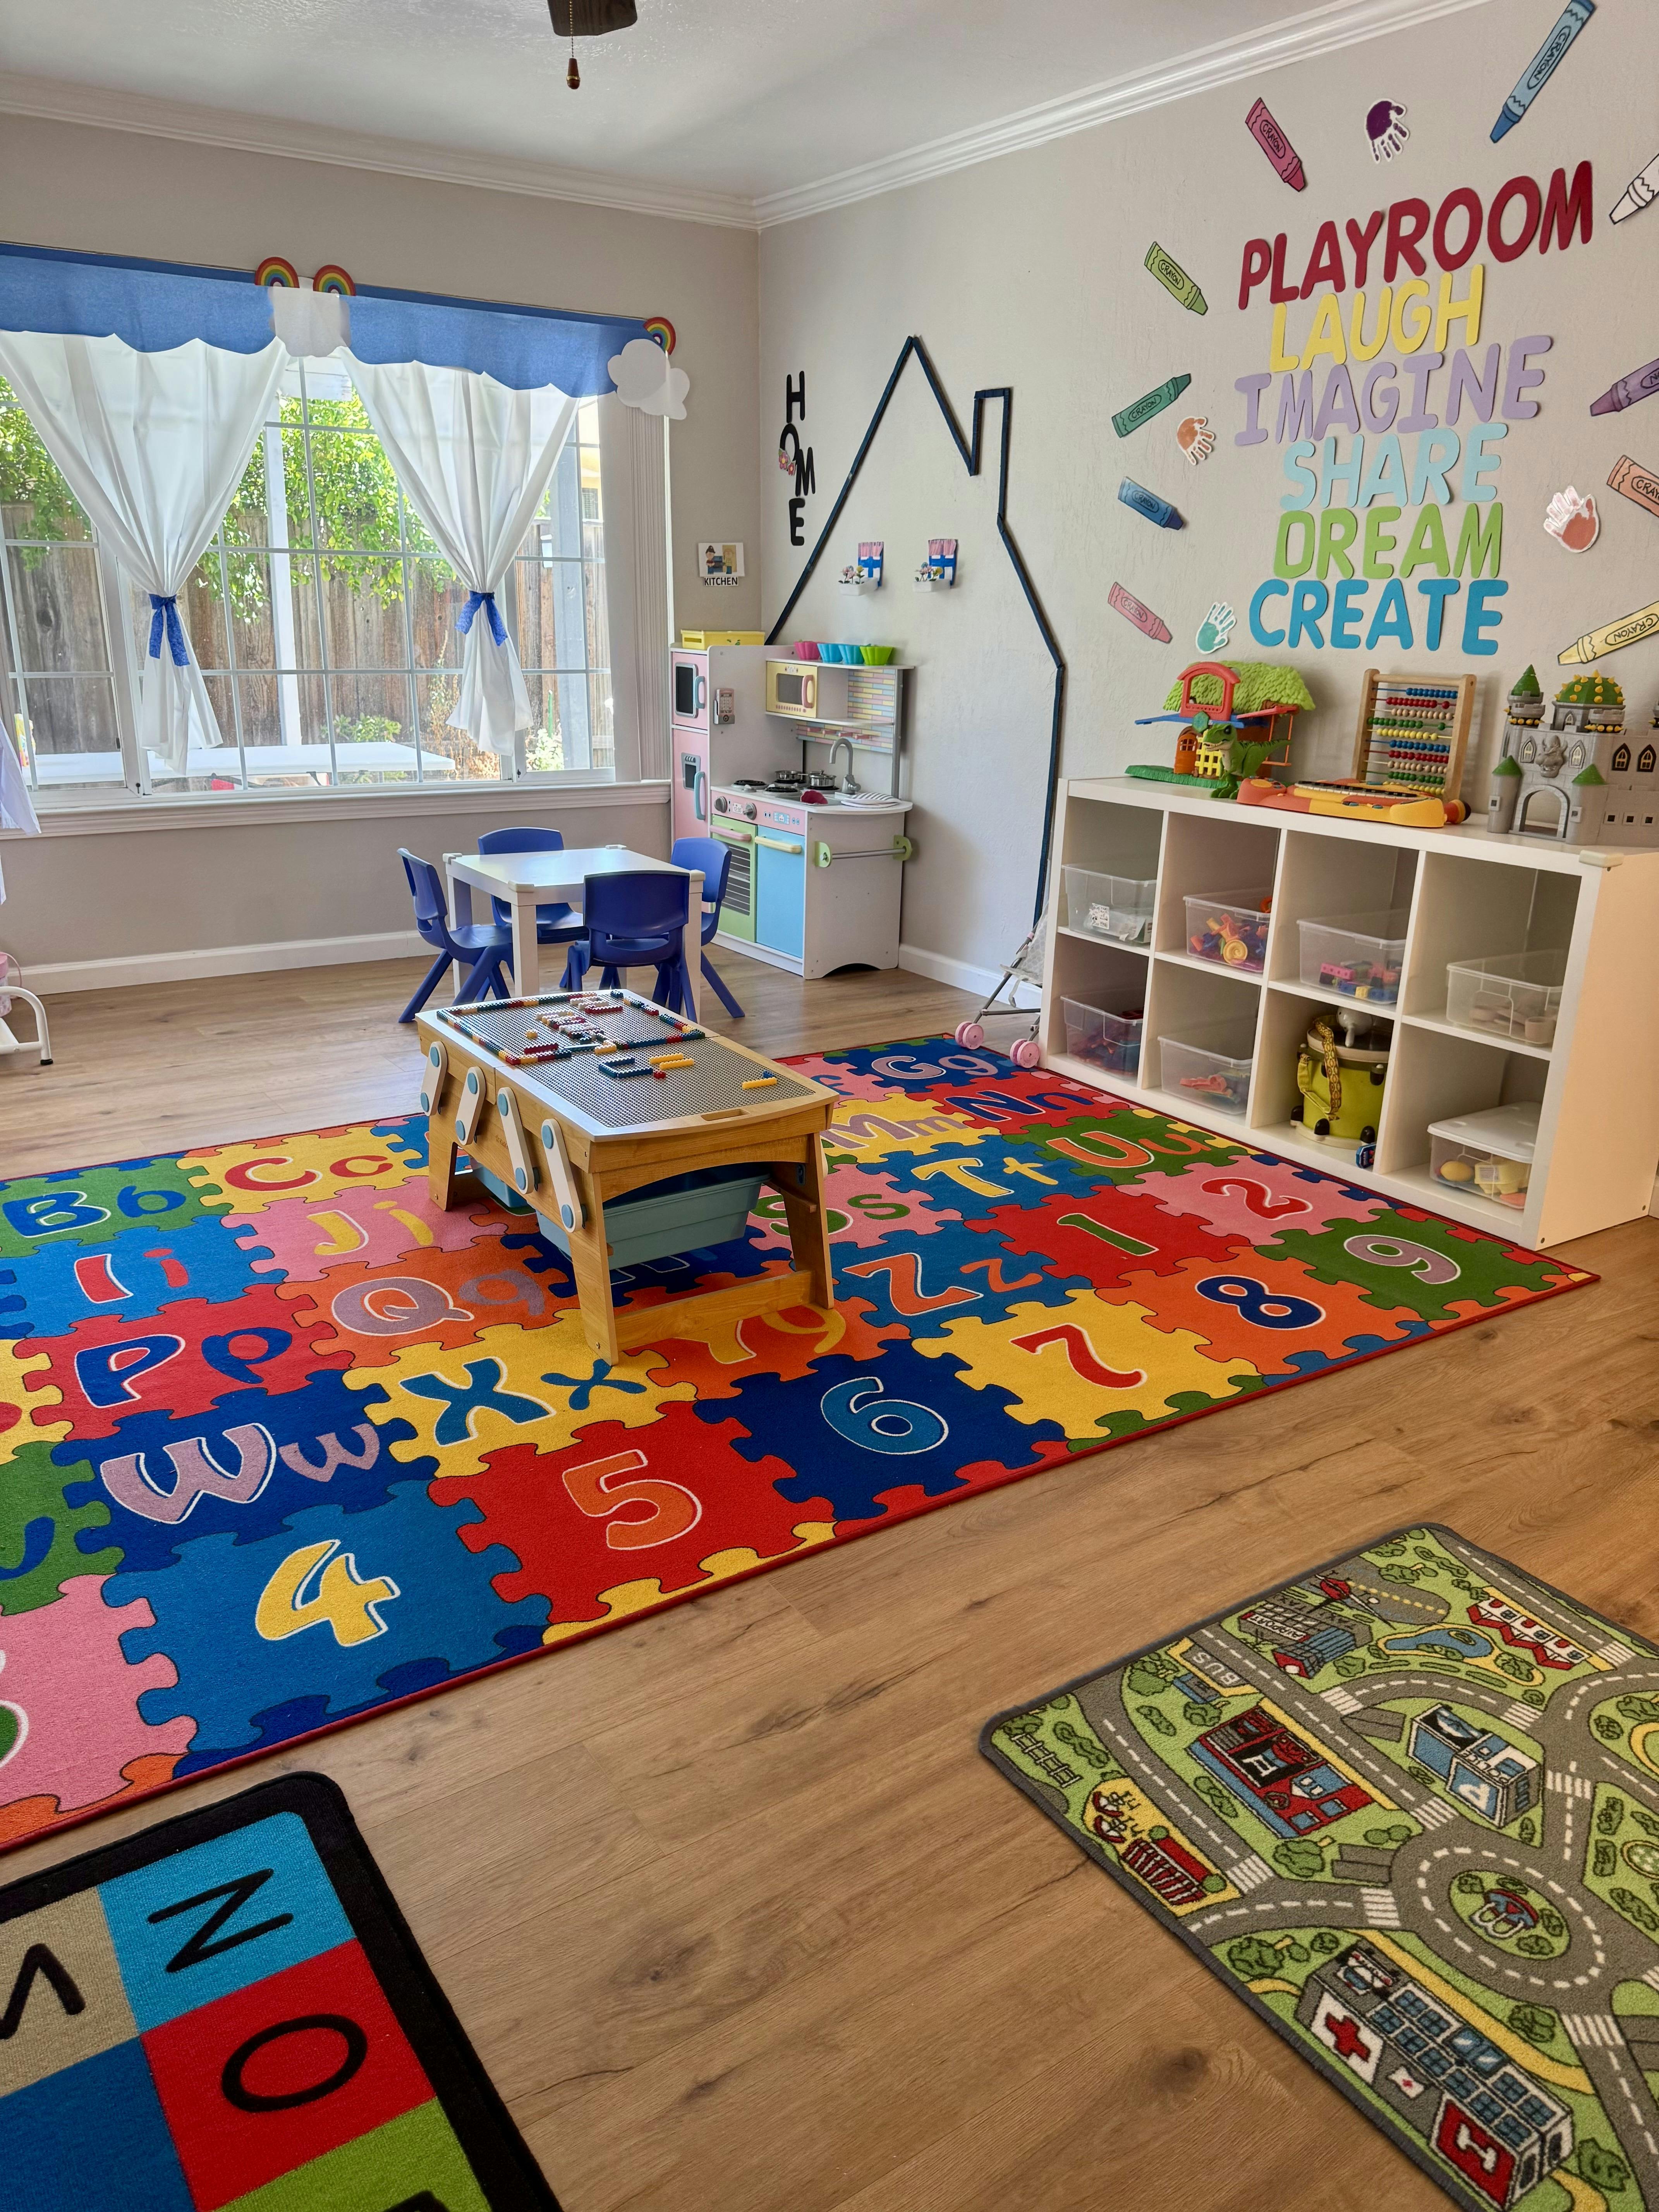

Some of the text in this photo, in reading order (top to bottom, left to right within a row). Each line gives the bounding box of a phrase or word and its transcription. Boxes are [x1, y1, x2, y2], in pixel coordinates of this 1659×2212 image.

[1534, 32, 1567, 81] CRAYON
[1262, 123, 1283, 153] CRAYON
[1238, 161, 1592, 310] PLAYROOM
[1161, 262, 1181, 285] CRAYON
[1270, 264, 1483, 373] LAUGH
[1131, 397, 1157, 419] CRAYON
[1234, 335, 1553, 447] IMAGINE
[1281, 423, 1508, 511] SHARE
[1134, 492, 1156, 510] CRAYON
[1273, 502, 1503, 580] DREAM
[704, 577, 738, 586] KITCHEN
[1123, 599, 1144, 618] CRAYON
[1248, 578, 1509, 656] CREATE
[1613, 617, 1654, 642] CRAYON
[1201, 1177, 1313, 1221] 2
[1056, 1212, 1159, 1257] 1
[1343, 1234, 1462, 1284] 9
[1195, 1275, 1327, 1329] 8
[1009, 1322, 1148, 1389] 7
[820, 1376, 949, 1455] 6
[562, 1449, 702, 1550] 5
[255, 1539, 400, 1647] 4
[1250, 1616, 1304, 1638] AIRPORT
[1191, 1652, 1241, 1686] BUS
[1461, 1749, 1510, 1783] POLICE
[1458, 1783, 1490, 1811] P
[220, 2013, 368, 2113] O
